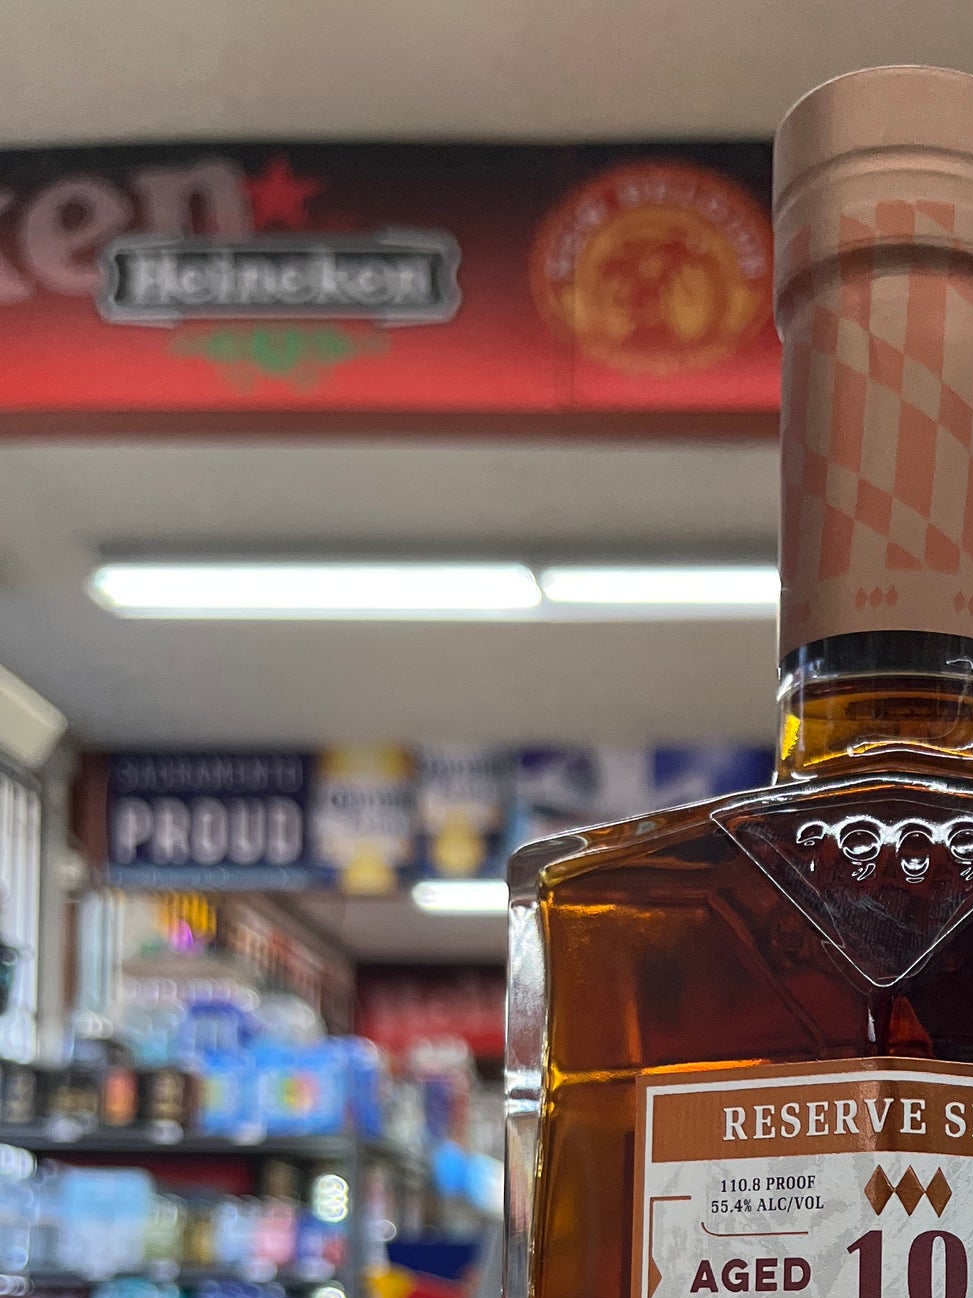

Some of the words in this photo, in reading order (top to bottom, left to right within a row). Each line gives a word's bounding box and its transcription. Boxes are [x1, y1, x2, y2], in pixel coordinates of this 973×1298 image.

[722, 1097, 927, 1142] RESERVE
[720, 1178, 761, 1193] 110.8
[765, 1175, 817, 1192] PROOF
[710, 1199, 753, 1214] 55.4%
[756, 1195, 825, 1213] ALC/VOL
[690, 1257, 812, 1293] AGED
